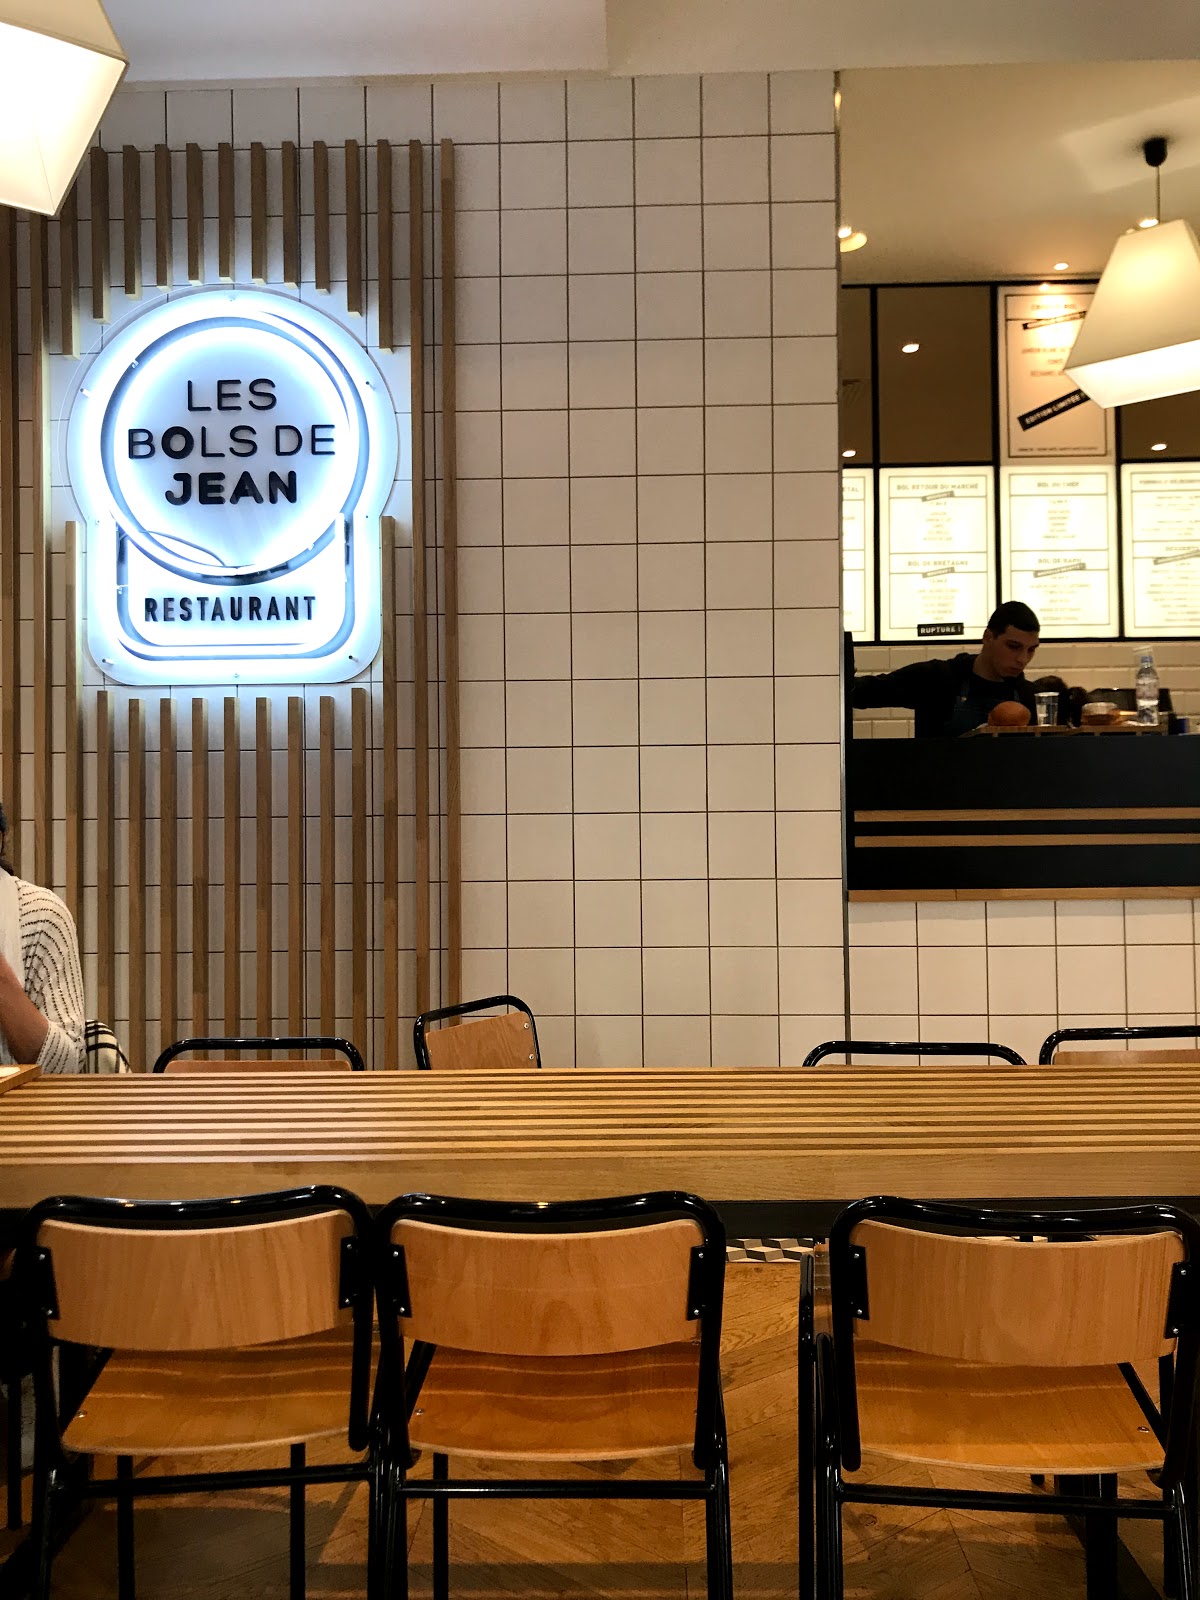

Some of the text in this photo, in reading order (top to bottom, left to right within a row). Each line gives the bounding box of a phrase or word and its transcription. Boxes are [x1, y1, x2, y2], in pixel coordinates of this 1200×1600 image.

[187, 379, 277, 411] LES
[128, 424, 336, 459] BOLS DE
[165, 470, 297, 506] JEAN
[144, 595, 316, 622] RESTAURANT
[920, 626, 956, 634] RUPTURE
